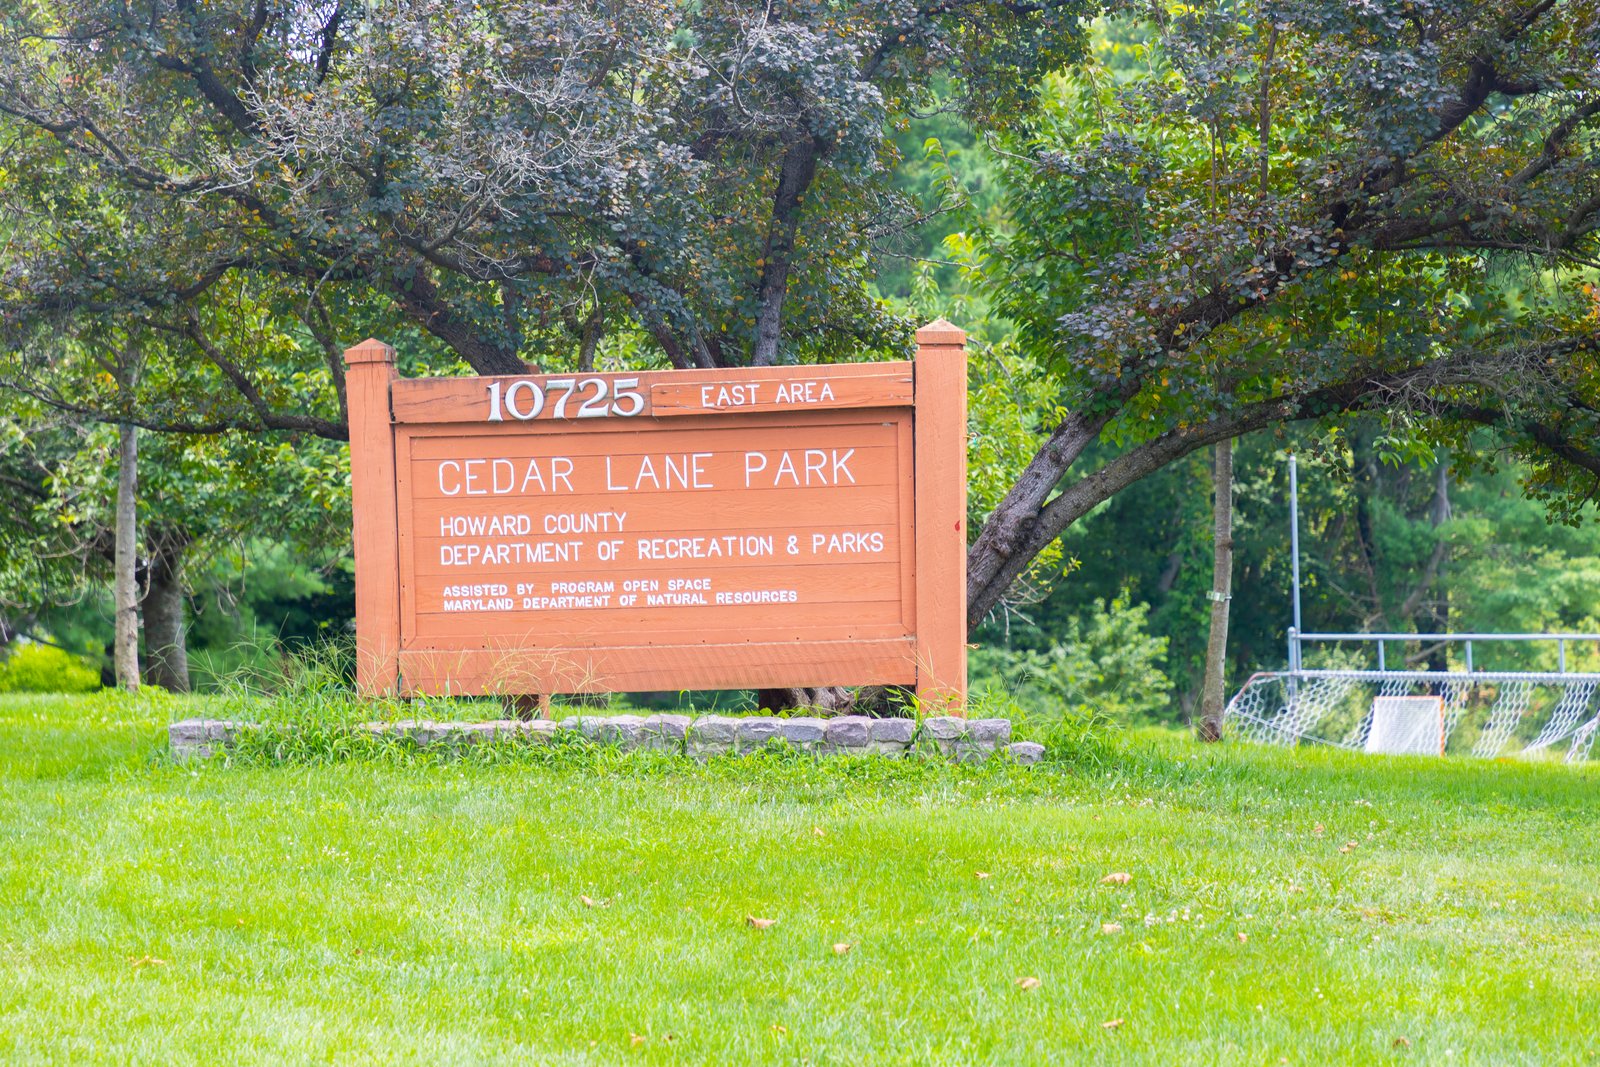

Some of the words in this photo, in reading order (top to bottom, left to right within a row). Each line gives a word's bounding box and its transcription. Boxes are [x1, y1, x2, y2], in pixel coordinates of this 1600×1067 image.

[486, 377, 646, 422] 10725
[701, 383, 761, 407] EAST
[776, 381, 835, 404] AREA
[438, 456, 574, 496] CEDAR
[606, 453, 714, 491] LANE
[744, 448, 856, 487] PARK
[440, 514, 531, 537] HOWARD
[544, 511, 627, 535] COUNTY
[440, 540, 583, 566] DEPARTMENT
[597, 540, 625, 561] OF
[637, 535, 774, 560] RECREATION
[786, 535, 800, 555] &
[812, 531, 884, 554] PARKS
[443, 583, 508, 598] ASSISTED
[516, 582, 534, 596] BY
[551, 580, 615, 594] PROGRAM
[622, 579, 660, 593] OPEN
[667, 577, 712, 591] SPACE
[443, 597, 514, 612] MARYLAND
[522, 594, 610, 610] DEPARTMENT
[618, 593, 637, 607] OF
[646, 591, 708, 606] NATURAL
[715, 589, 798, 605] RESOURCES
